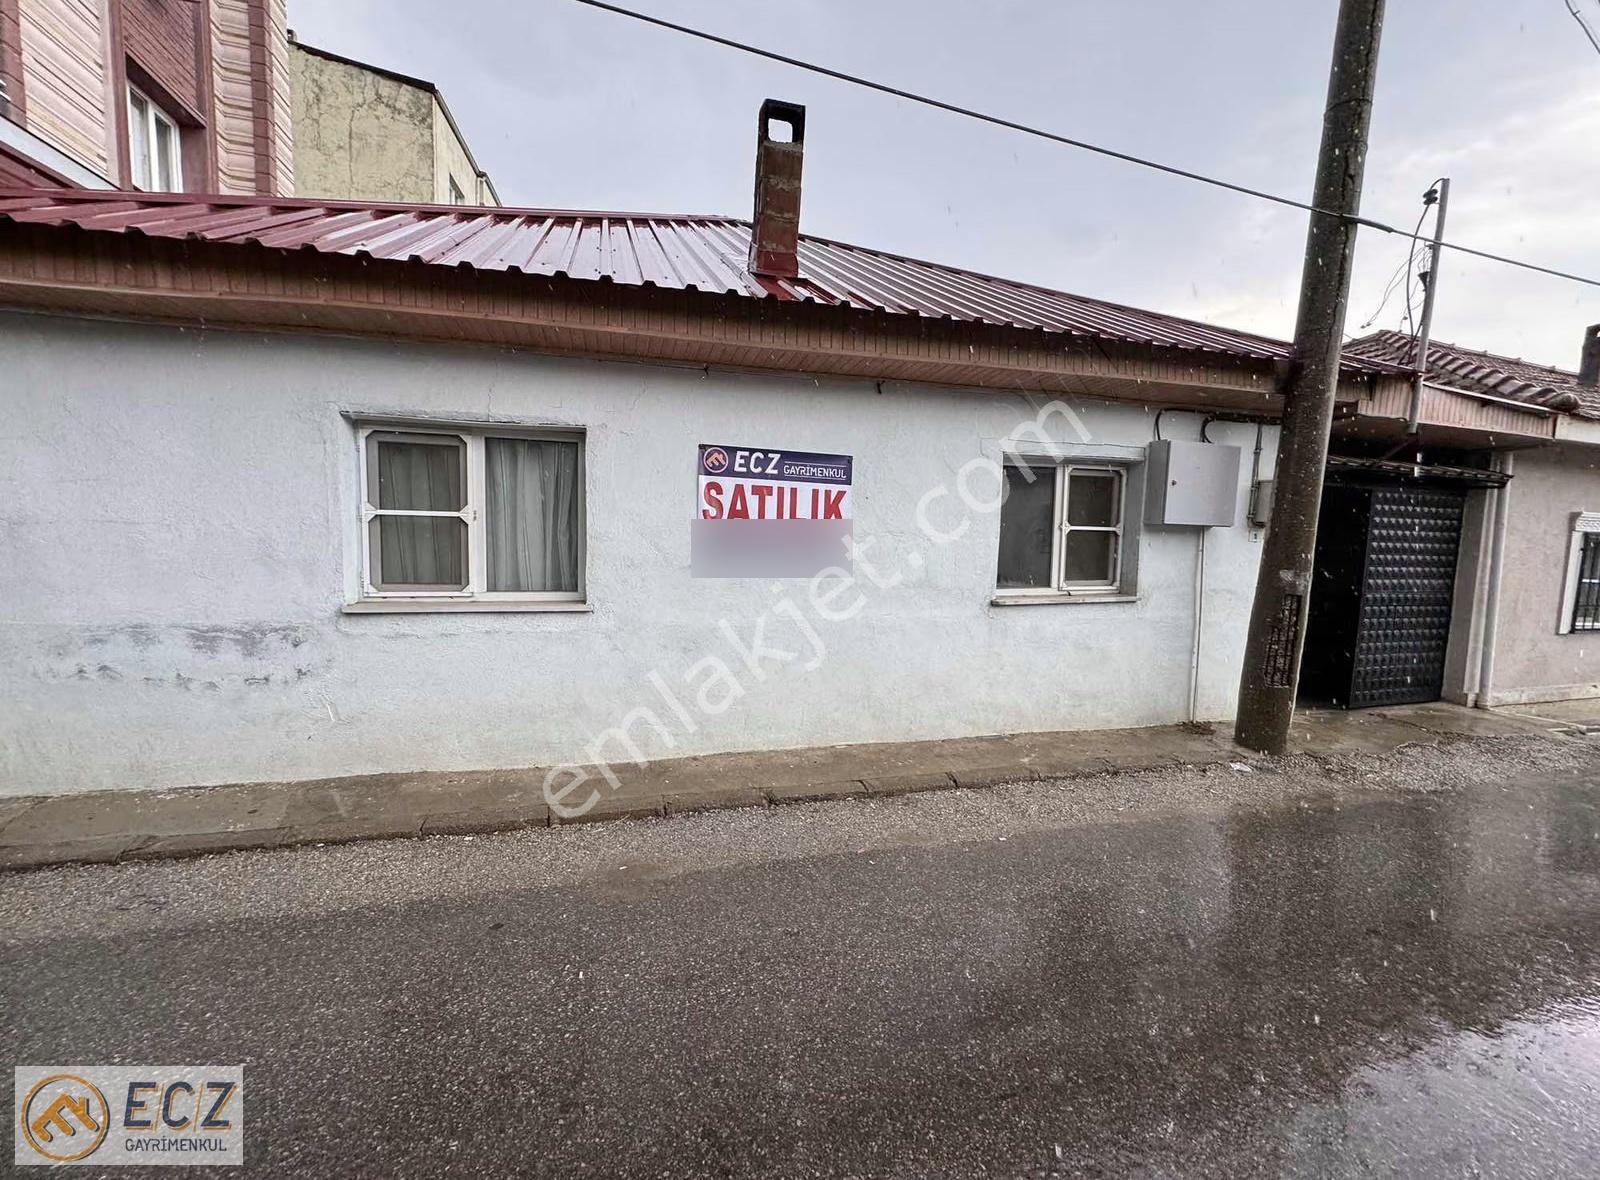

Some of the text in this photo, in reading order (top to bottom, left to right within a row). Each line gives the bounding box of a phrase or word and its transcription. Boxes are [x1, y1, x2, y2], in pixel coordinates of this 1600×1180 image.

[734, 450, 847, 479] ECZ GAYRİMENKUL
[702, 481, 847, 519] SATILIK
